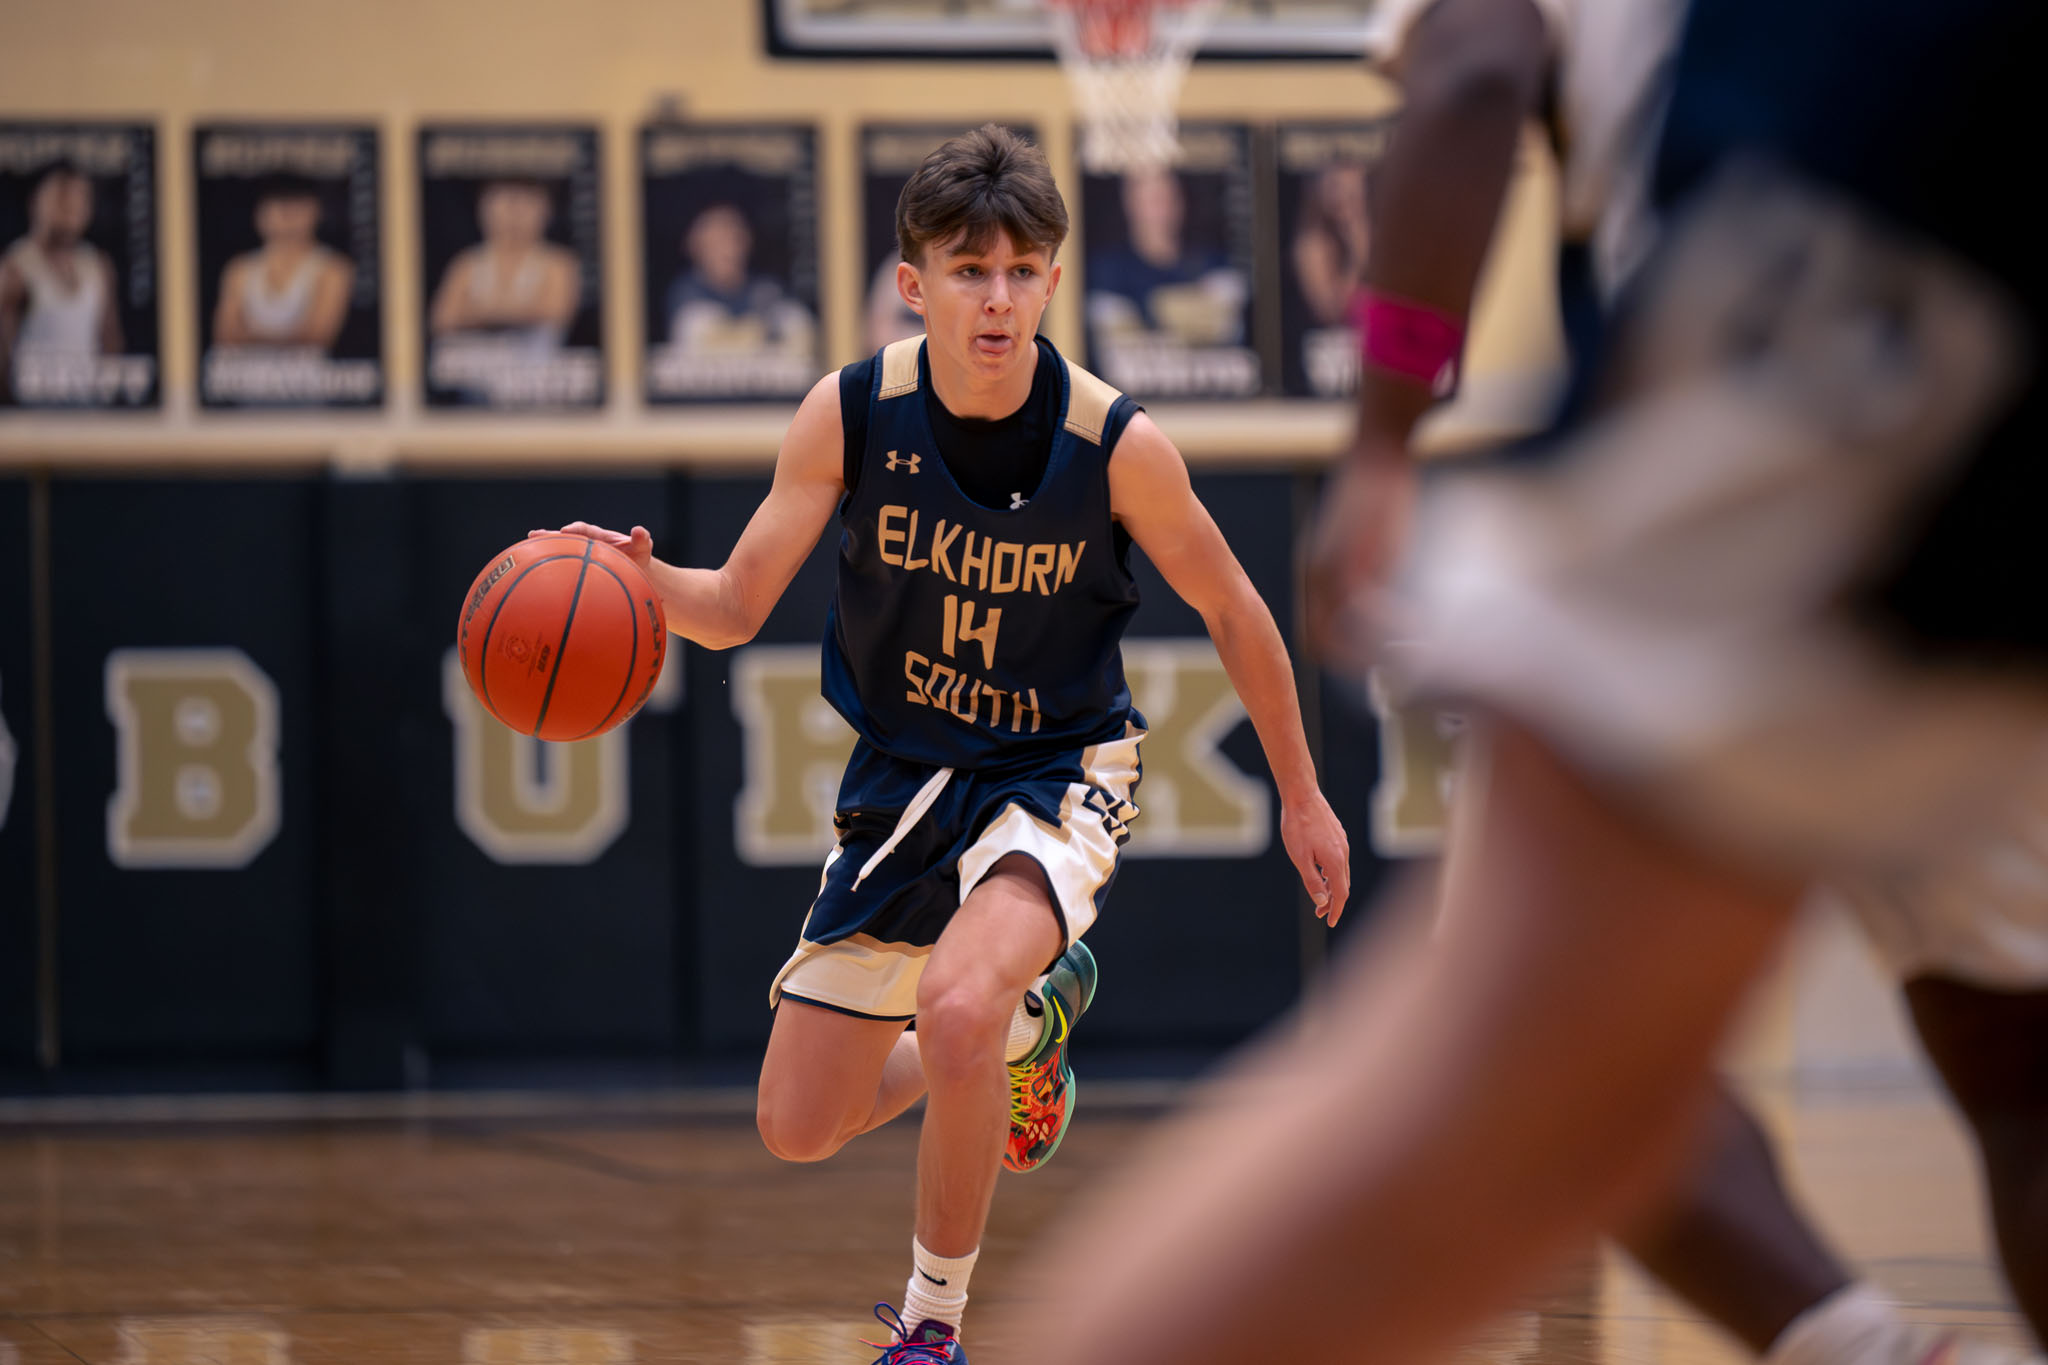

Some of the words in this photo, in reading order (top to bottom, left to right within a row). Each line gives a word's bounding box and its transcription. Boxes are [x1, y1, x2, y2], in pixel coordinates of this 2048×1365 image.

[878, 505, 1086, 595] ELKHORN
[943, 594, 1002, 670] 14
[905, 651, 1041, 733] SOUTH
